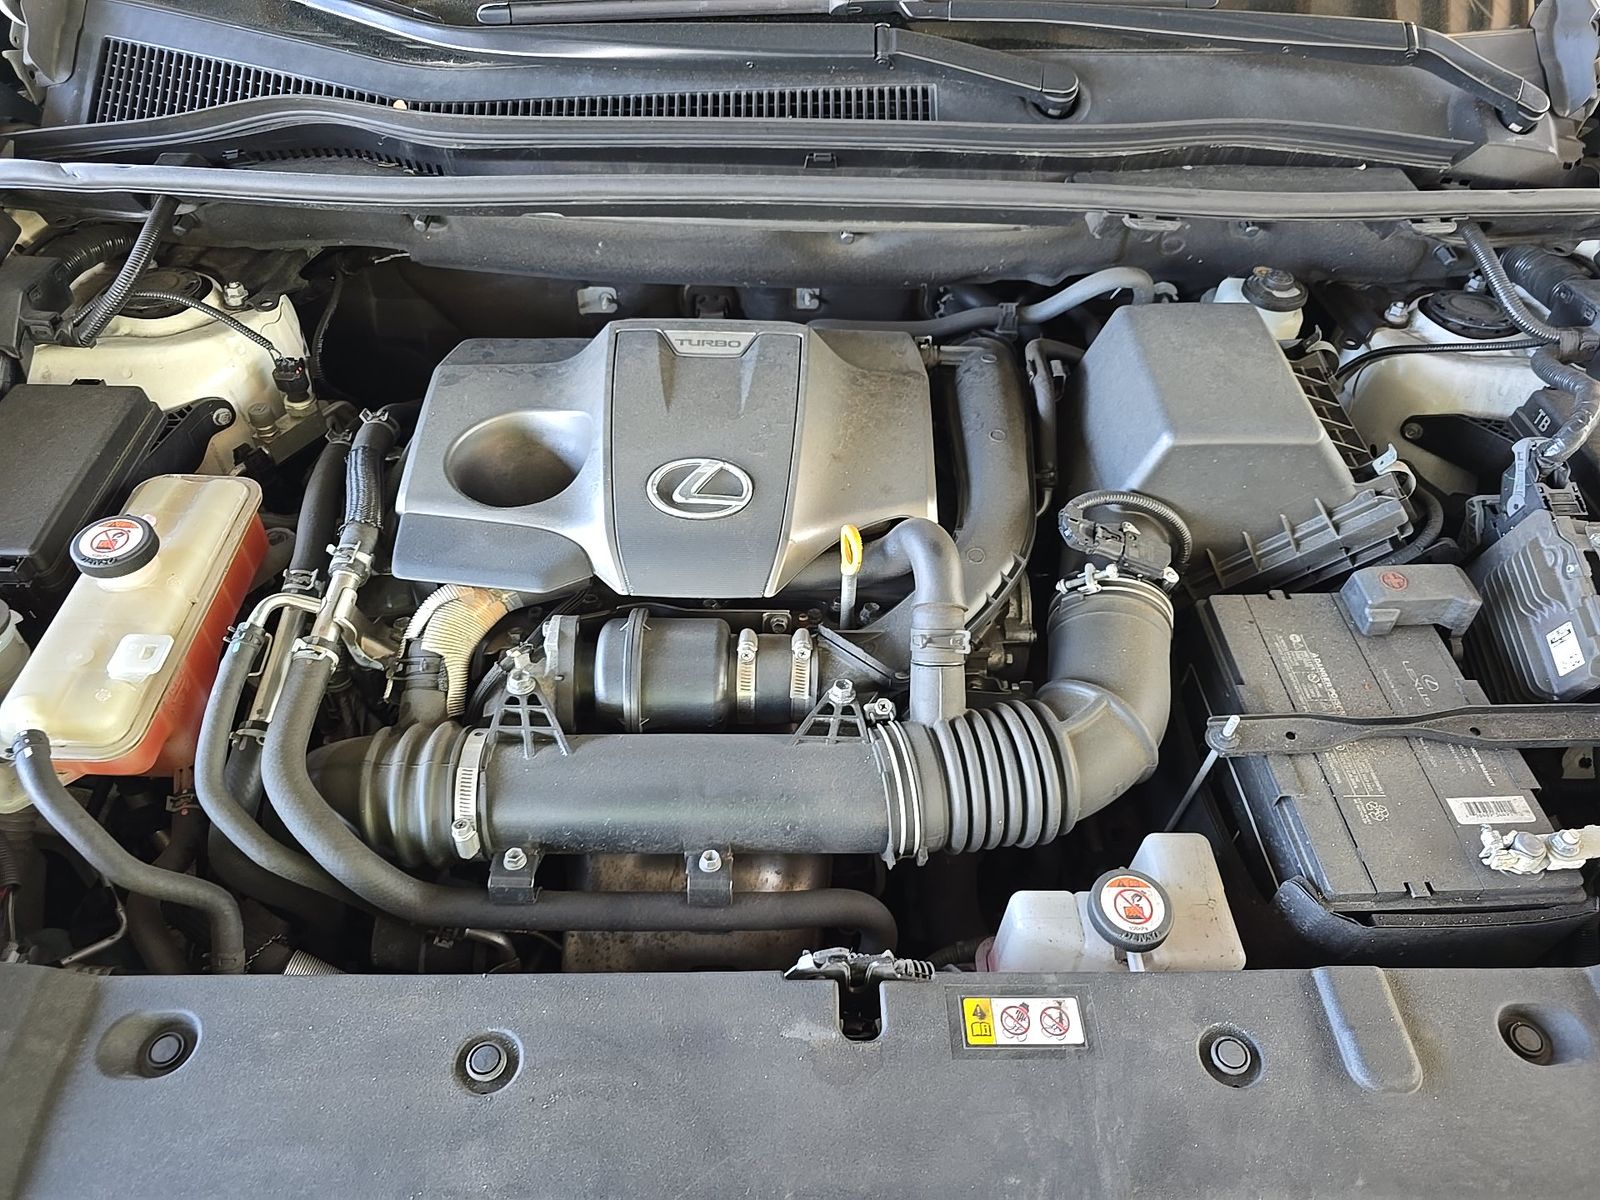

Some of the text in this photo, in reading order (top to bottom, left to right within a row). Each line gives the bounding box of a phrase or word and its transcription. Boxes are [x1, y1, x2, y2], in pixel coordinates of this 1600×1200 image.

[674, 338, 742, 349] TURBO
[1533, 408, 1551, 432] TB
[1402, 660, 1432, 708] LEXUS
[1119, 931, 1162, 943] DENSO
